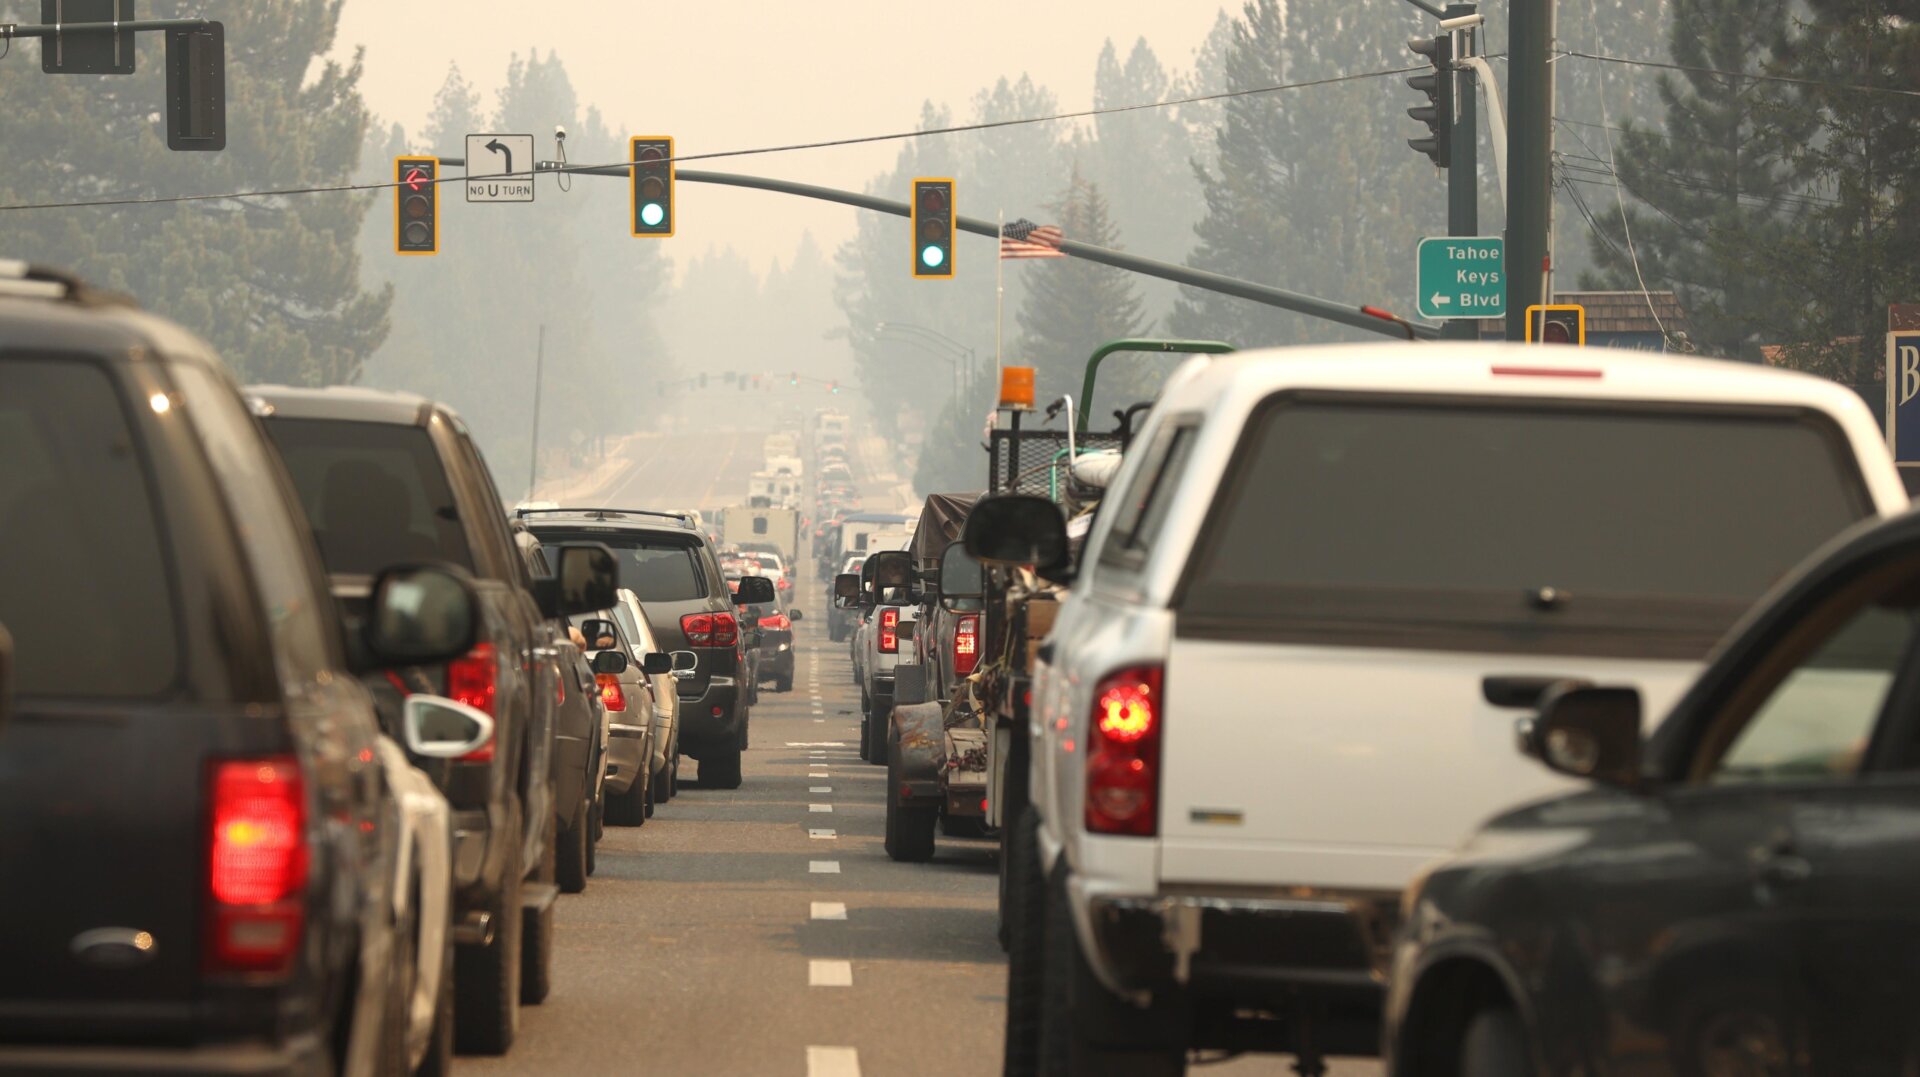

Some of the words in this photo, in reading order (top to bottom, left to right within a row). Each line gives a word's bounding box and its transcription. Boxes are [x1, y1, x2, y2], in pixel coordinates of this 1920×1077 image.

[470, 186, 484, 195] NO
[488, 184, 498, 197] U
[503, 186, 531, 196] TURN
[1446, 246, 1500, 259] Tahoe
[1457, 269, 1500, 286] Keys
[1460, 293, 1500, 307] Blvd
